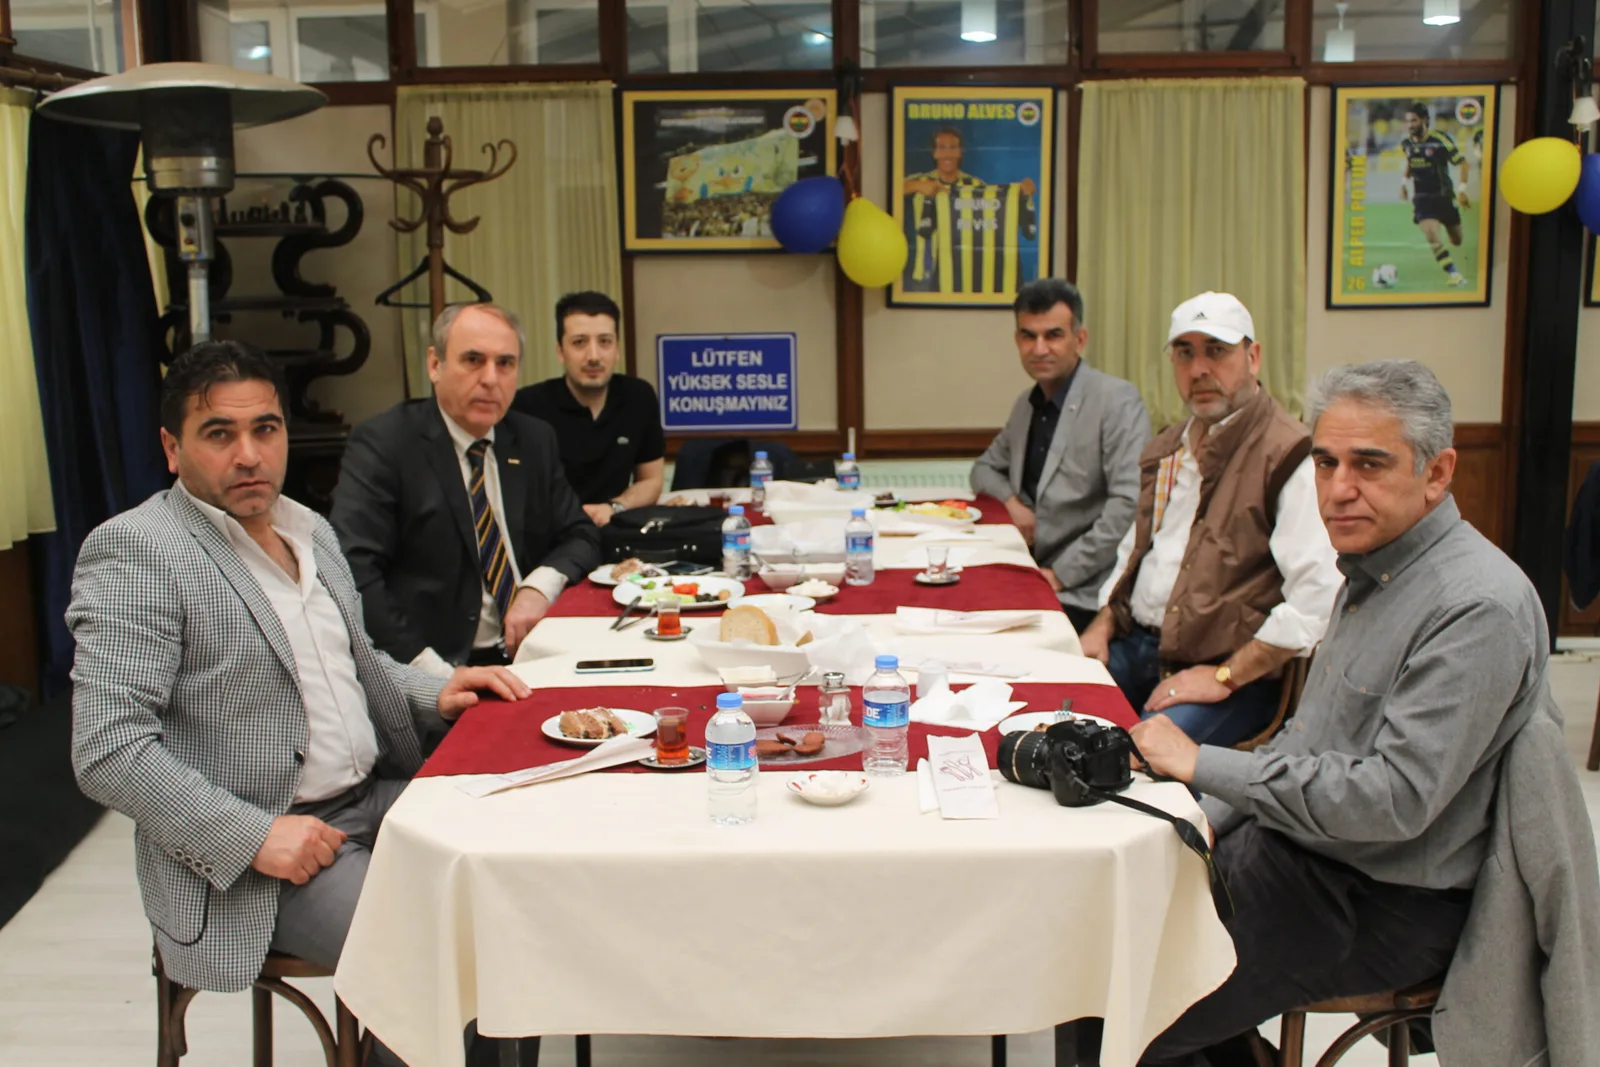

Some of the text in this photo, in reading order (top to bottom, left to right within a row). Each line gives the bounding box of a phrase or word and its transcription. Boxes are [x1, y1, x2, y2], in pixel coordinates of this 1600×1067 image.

[908, 103, 1016, 119] BRUNO ALVES
[954, 198, 1001, 212] BRUNO
[1349, 155, 1367, 267] ALPER POTUK
[957, 217, 998, 231] ALVES
[1347, 277, 1366, 290] 26
[691, 348, 763, 367] LÜTFEN
[668, 372, 788, 391] YÜKSEK SESLE
[668, 395, 788, 415] KONUŞMAYINIZ
